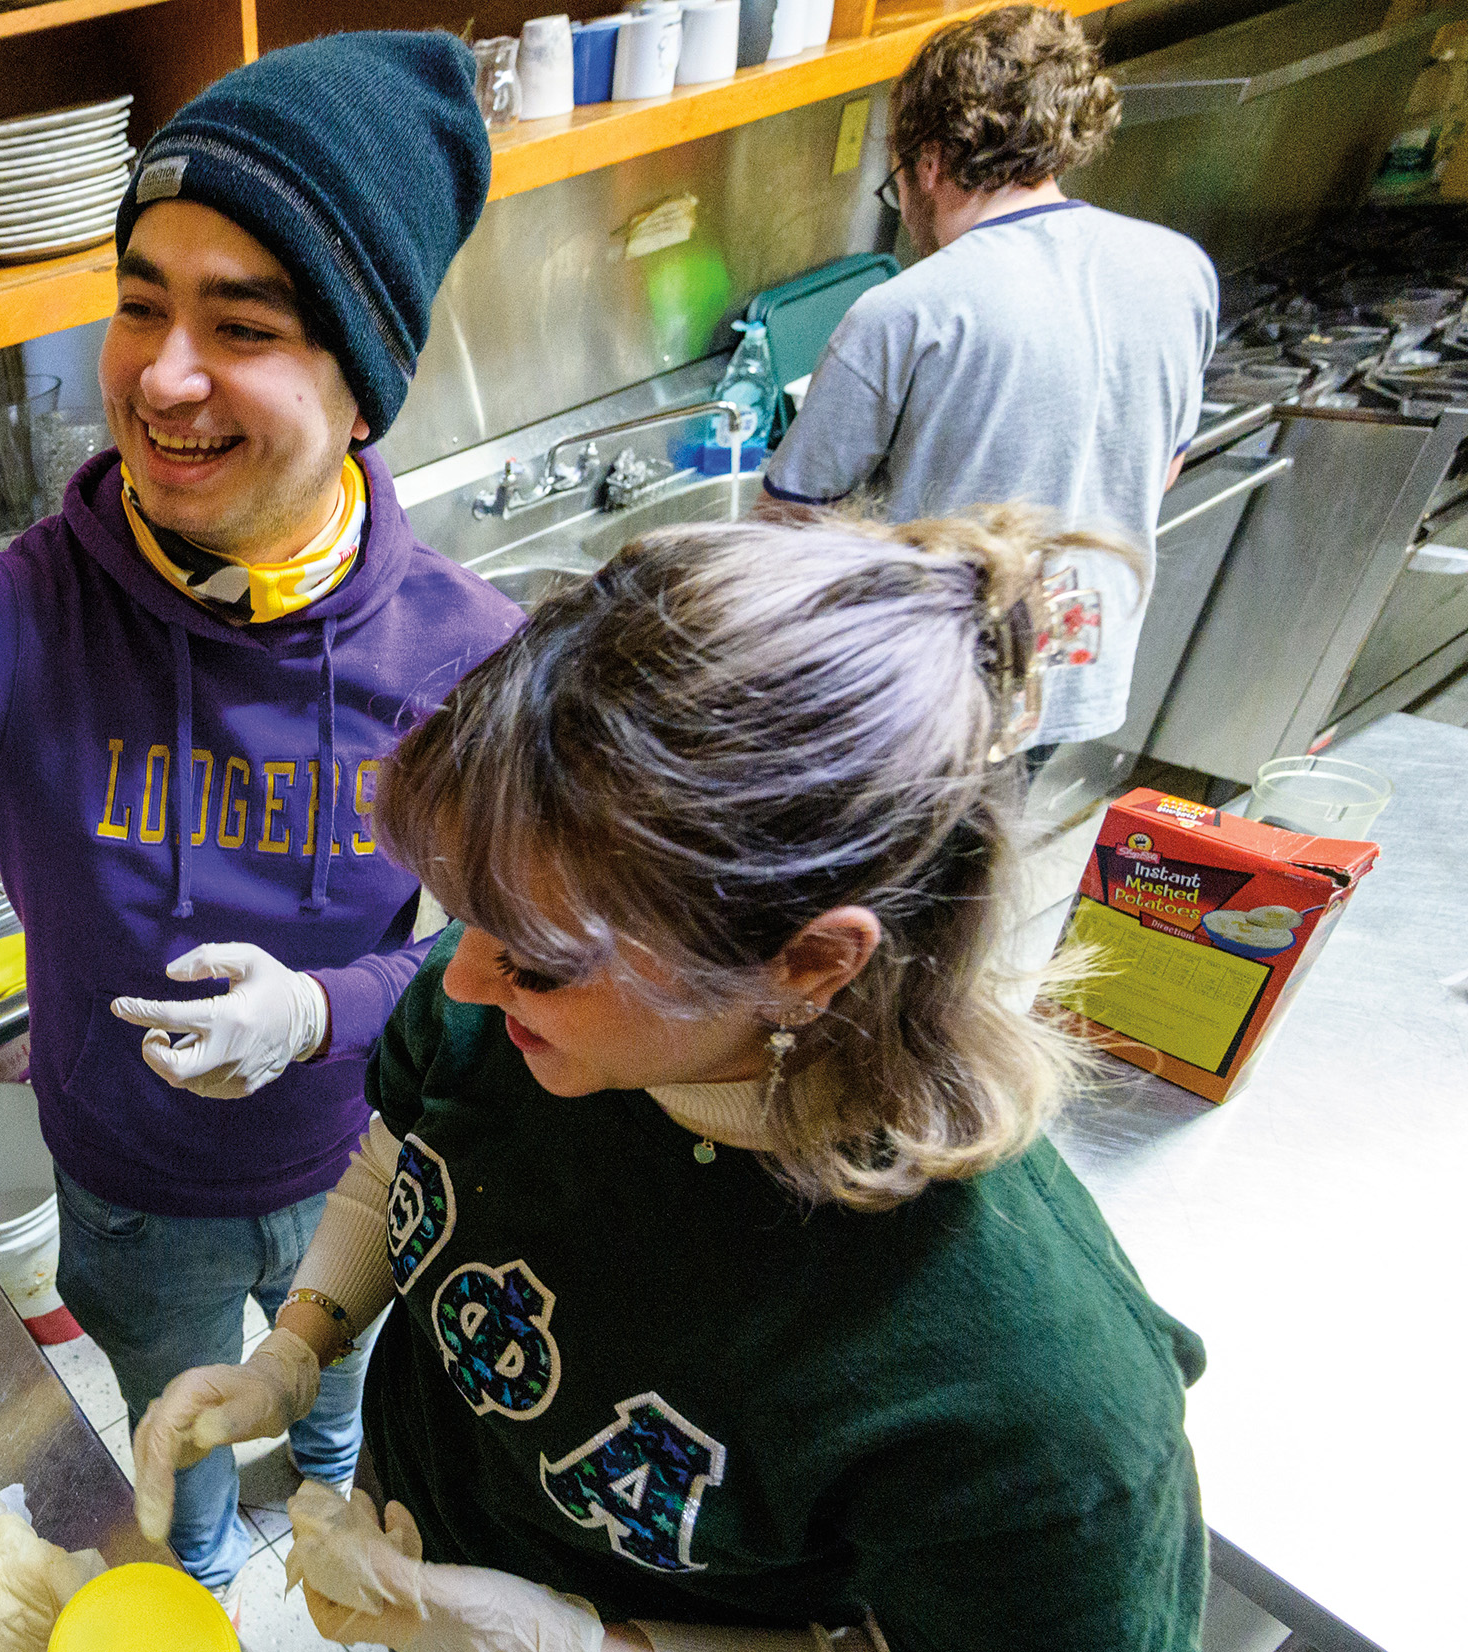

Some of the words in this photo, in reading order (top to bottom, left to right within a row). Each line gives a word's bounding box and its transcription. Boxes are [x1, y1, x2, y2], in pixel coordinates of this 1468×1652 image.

[1124, 873, 1200, 905] Mashed
[1134, 861, 1202, 889] Instant
[1114, 887, 1202, 921] Potatoes
[1150, 918, 1197, 942] Directions
